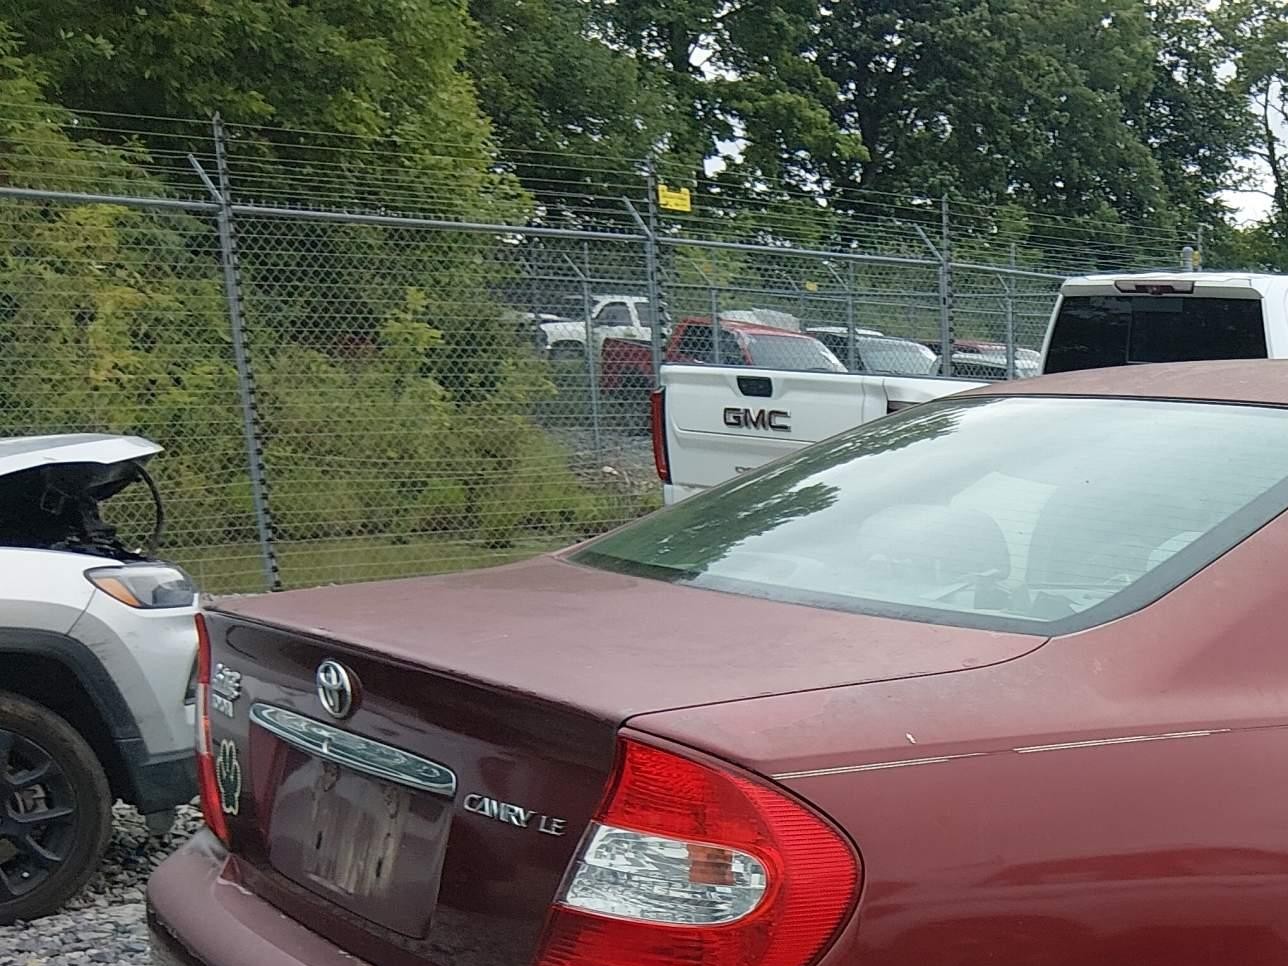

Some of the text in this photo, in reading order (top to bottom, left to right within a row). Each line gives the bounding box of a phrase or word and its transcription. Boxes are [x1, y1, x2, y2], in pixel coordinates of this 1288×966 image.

[723, 407, 791, 432] GMC
[463, 793, 568, 836] CAMRY LE
